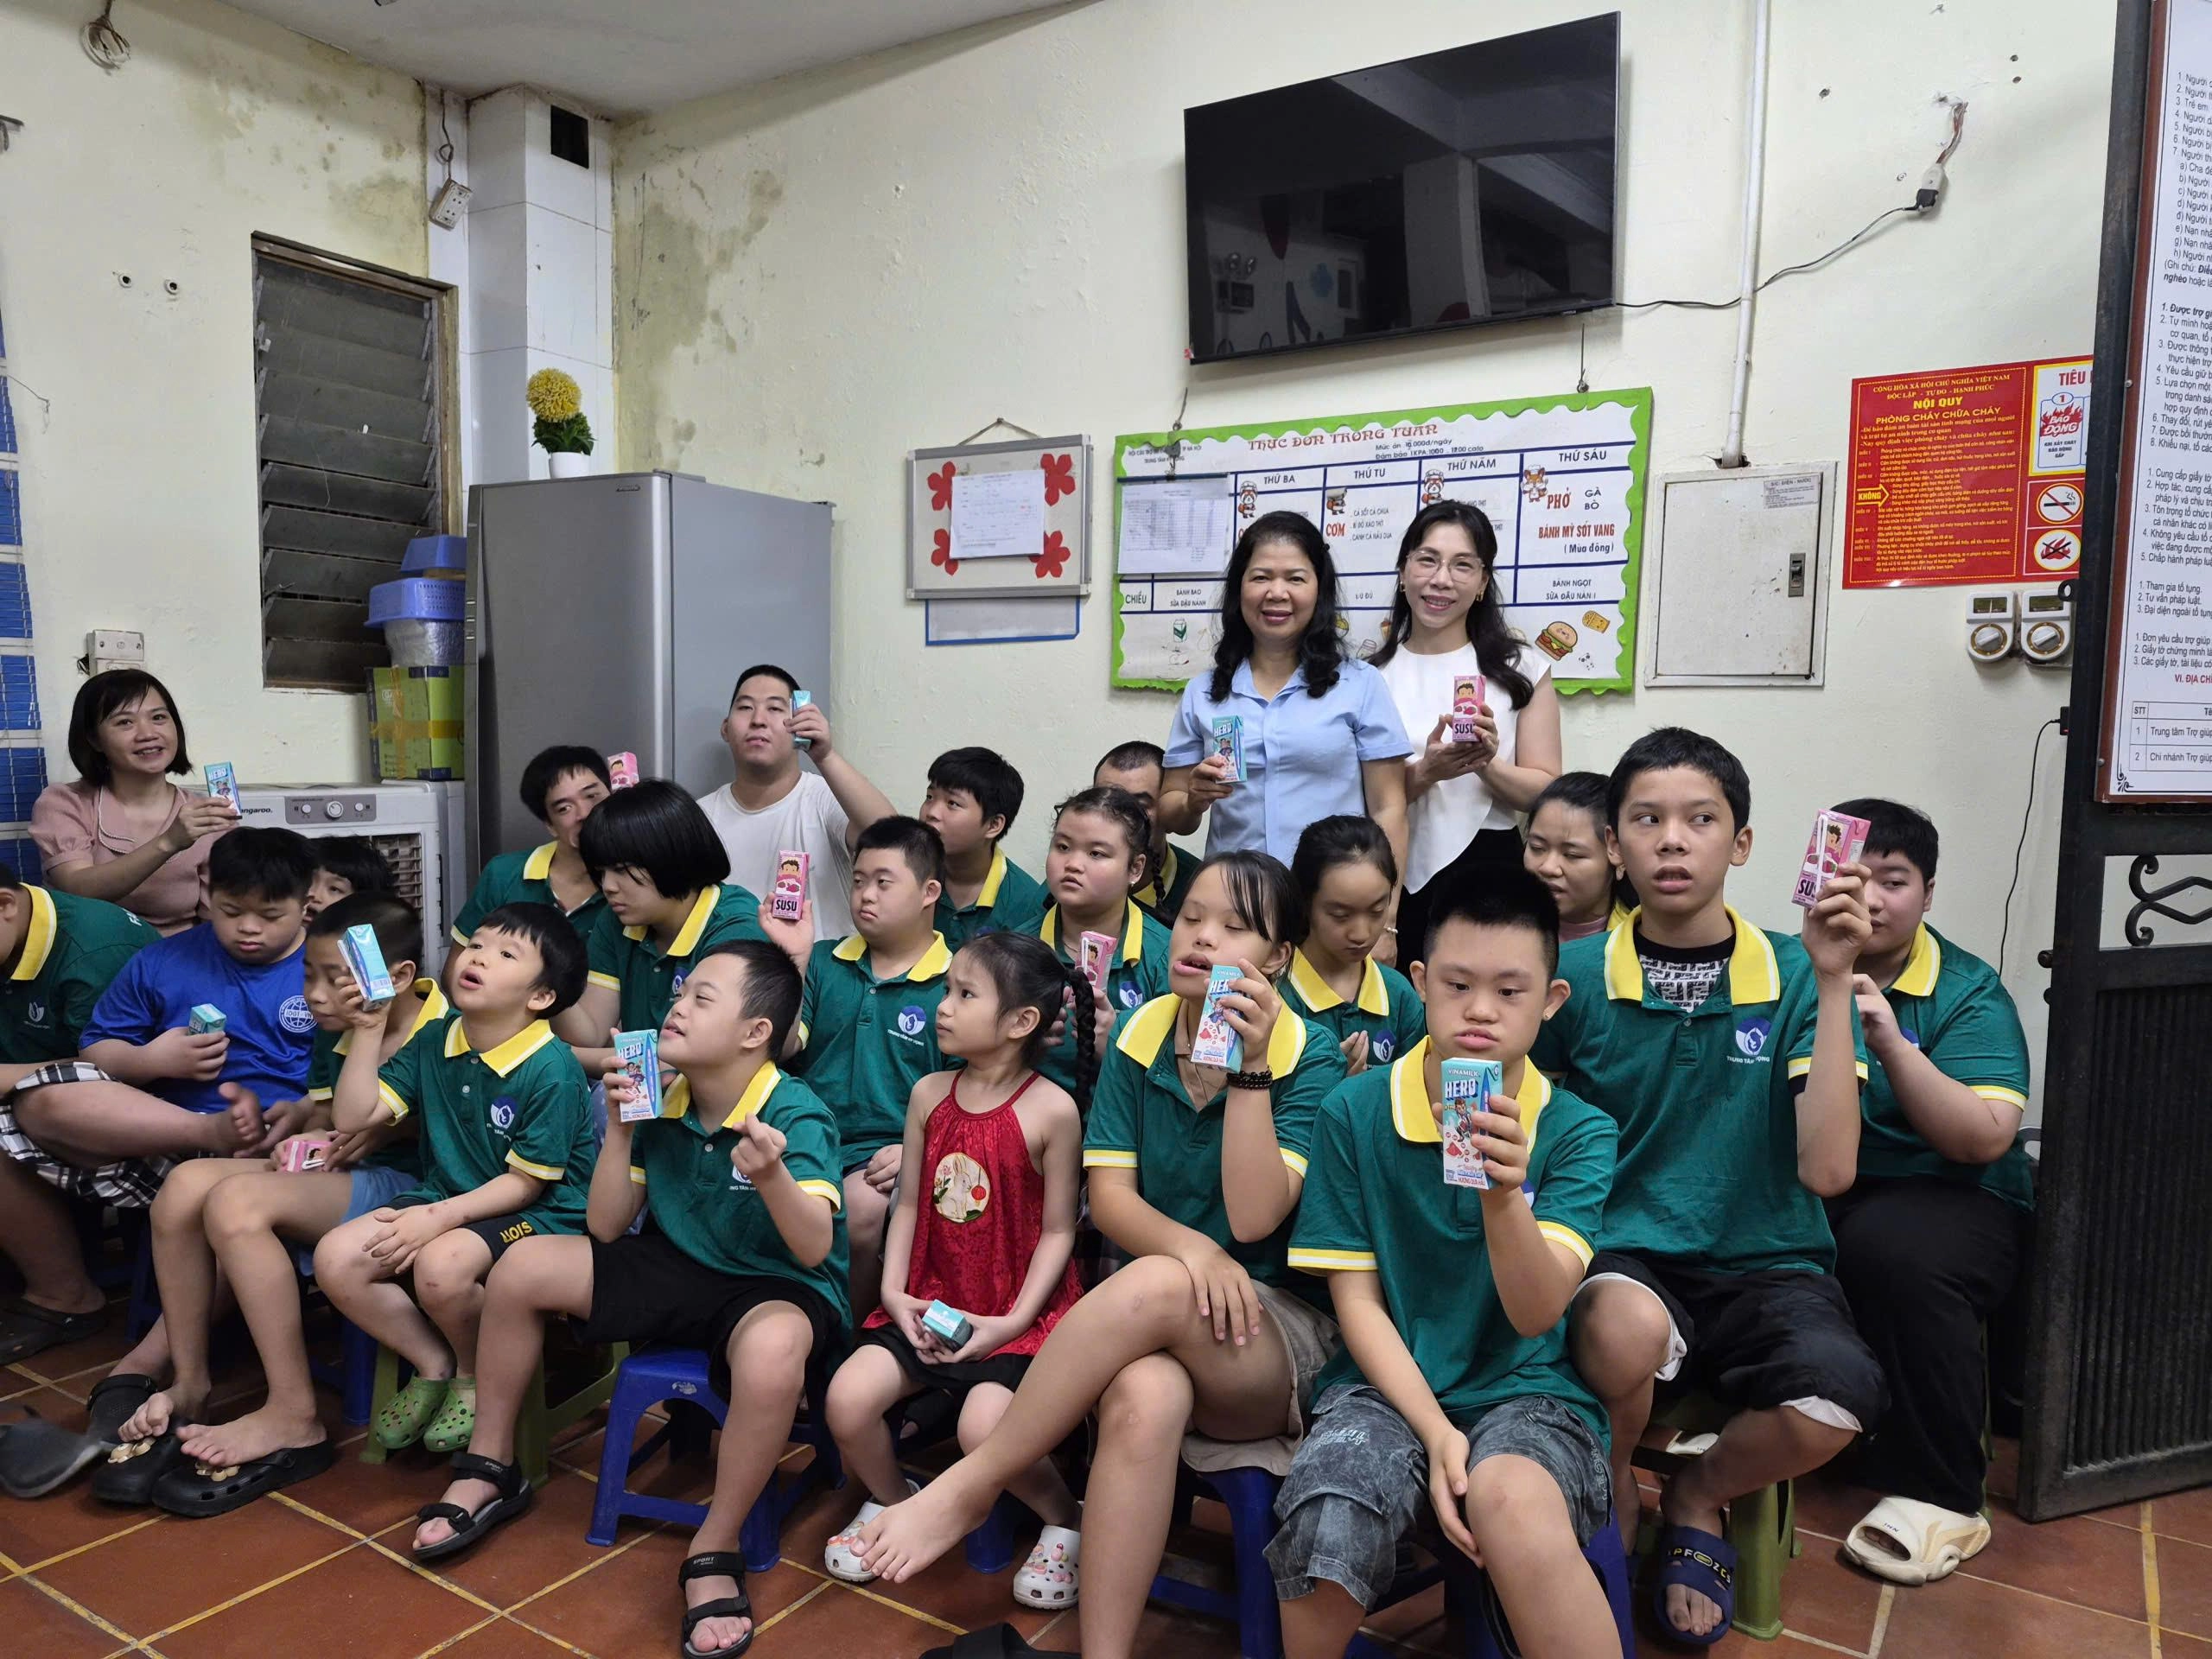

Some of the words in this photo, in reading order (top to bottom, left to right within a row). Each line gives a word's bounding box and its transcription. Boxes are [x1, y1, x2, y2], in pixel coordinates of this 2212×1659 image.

[2170, 303, 2192, 316] Được
[2167, 340, 2189, 352] Được
[2190, 344, 2209, 356] thông
[1873, 384, 1893, 393] CỘNG
[1920, 381, 1934, 390] HỘI
[1974, 375, 1993, 385] VIỆT
[1993, 373, 2011, 383] NAM
[2058, 368, 2087, 387] TIÊU
[1974, 383, 1994, 393] PHÚC
[2179, 379, 2196, 391] chọn
[2059, 394, 2066, 403] 1
[2165, 390, 2183, 403] trong
[2184, 392, 2202, 403] danh
[1913, 397, 1935, 410] NỘI
[1938, 396, 1963, 409] QUY
[1876, 413, 1910, 424] PHÒNG
[1912, 410, 1940, 422] CHÁY
[1942, 407, 1970, 419] CHỮA
[1972, 406, 2002, 417] CHÁY
[2179, 405, 2193, 416] quy
[2160, 414, 2178, 426] Thay
[2044, 422, 2081, 437] ĐỘNG
[1559, 448, 1581, 462] THỨ
[1584, 448, 1607, 461] SÁU
[1447, 457, 1467, 471] THỨ
[1469, 456, 1497, 469] NĂM
[1263, 475, 1281, 486] THỨ
[1282, 474, 1296, 485] BA
[1354, 469, 1372, 480] THỨ
[2155, 467, 2174, 481] Cung
[1584, 486, 1602, 498] GÀ
[1858, 491, 1882, 501] KHÔNG
[2185, 484, 2202, 496] cung
[1547, 486, 1572, 510] PHỞ
[2155, 493, 2172, 504] pháp
[1584, 499, 1599, 511] BÒ
[2165, 506, 2184, 518] trọng
[1538, 524, 1560, 540] BÁNH
[1562, 523, 1575, 537] MỲ
[1593, 523, 1615, 537] VANG
[2150, 528, 2172, 542] Không
[2183, 544, 2203, 556] được
[1573, 579, 1592, 588] NGỌT
[2146, 580, 2164, 591] Tham
[2165, 582, 2177, 594] gia
[2170, 595, 2187, 606] pháp
[2172, 607, 2191, 618] ngoài
[2142, 632, 2158, 642] Đơn
[2196, 637, 2211, 647] giúp
[2142, 643, 2158, 657] Giấy
[2166, 646, 2189, 658] chứng
[2189, 647, 2206, 657] minh
[2140, 657, 2154, 666] Các
[2185, 673, 2199, 684] ĐỊA
[2133, 706, 2147, 715] STT
[1213, 721, 1234, 738] HERO
[2151, 726, 2171, 738] Trung
[2171, 728, 2185, 737] tâm
[2186, 727, 2198, 739] Trợ
[2135, 752, 2140, 761] 2
[2150, 752, 2162, 762] Chi
[2163, 753, 2185, 763] nhánh
[2186, 753, 2198, 763] Trợ
[775, 899, 798, 912] SUSU
[620, 1042, 644, 1060] HERO
[1448, 1066, 1480, 1078] VINAMILK
[1444, 1077, 1478, 1100] HERO
